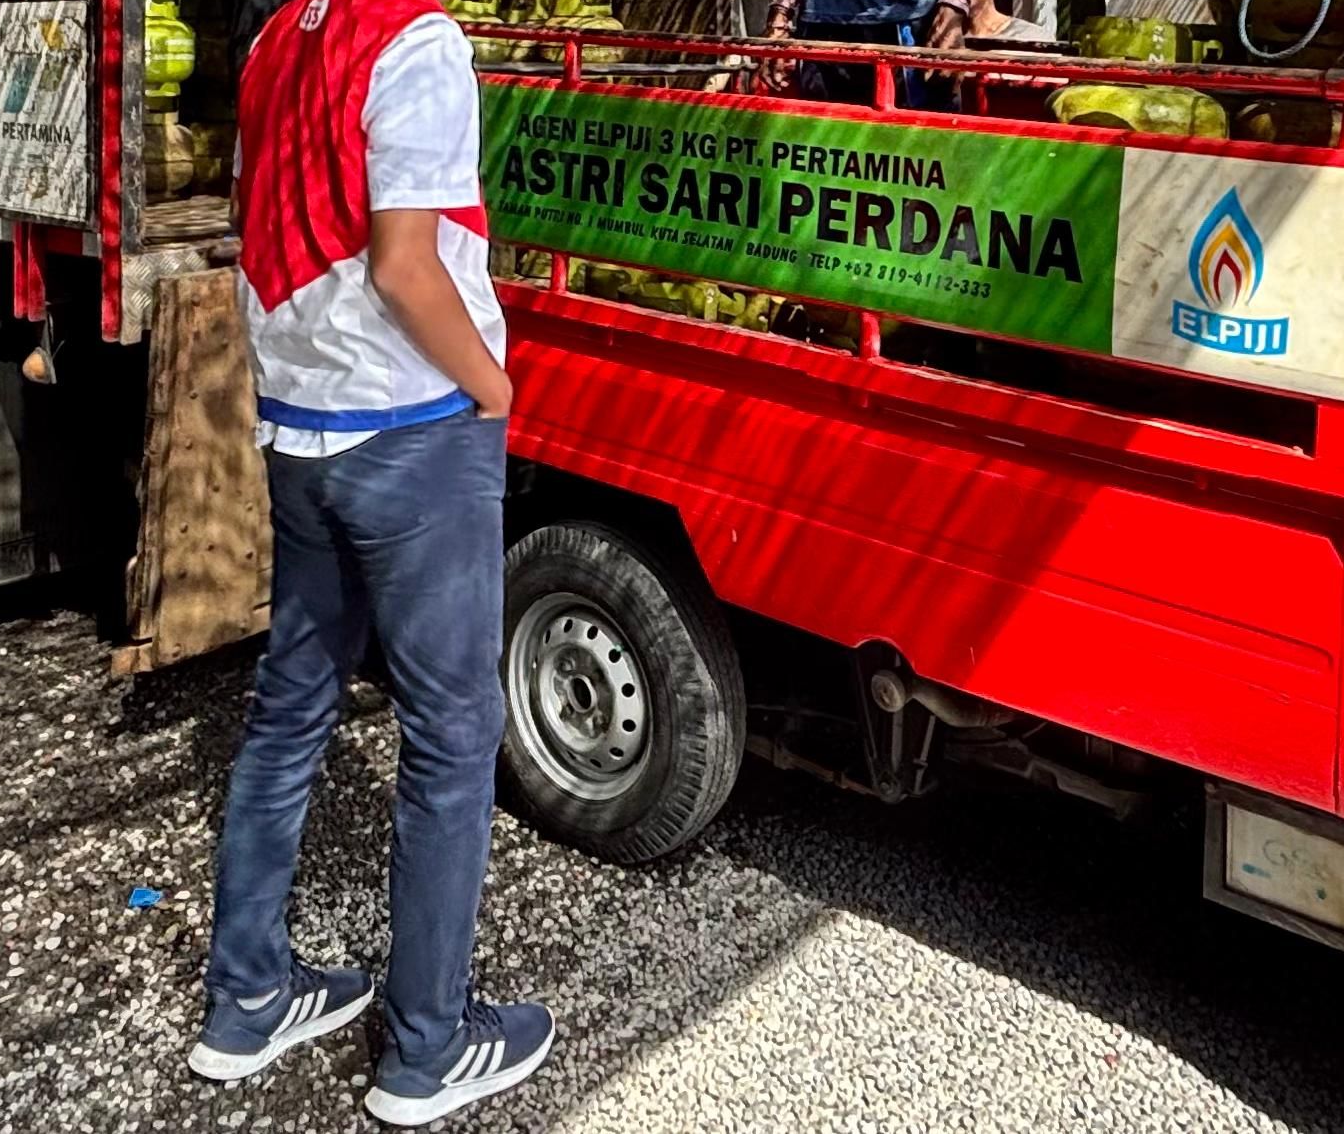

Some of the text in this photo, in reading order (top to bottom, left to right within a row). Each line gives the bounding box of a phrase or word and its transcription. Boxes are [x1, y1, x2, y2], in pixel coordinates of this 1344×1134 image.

[1, 122, 73, 145] PERTAMINA
[516, 113, 946, 191] AGEN ELPIJI 3 KG PT. PERTAMINA
[500, 144, 1083, 284] ASTRI SARI PERDANA
[534, 206, 565, 223] PUTRI
[597, 216, 645, 238] MUMBUL
[650, 225, 679, 244] KUTA
[682, 230, 734, 253] SELATAN
[745, 241, 798, 264] BADUNG
[809, 252, 841, 272] TELP
[844, 262, 873, 278] +62
[876, 264, 992, 299] 819-4112-333
[1178, 307, 1282, 353] ELPIJI
